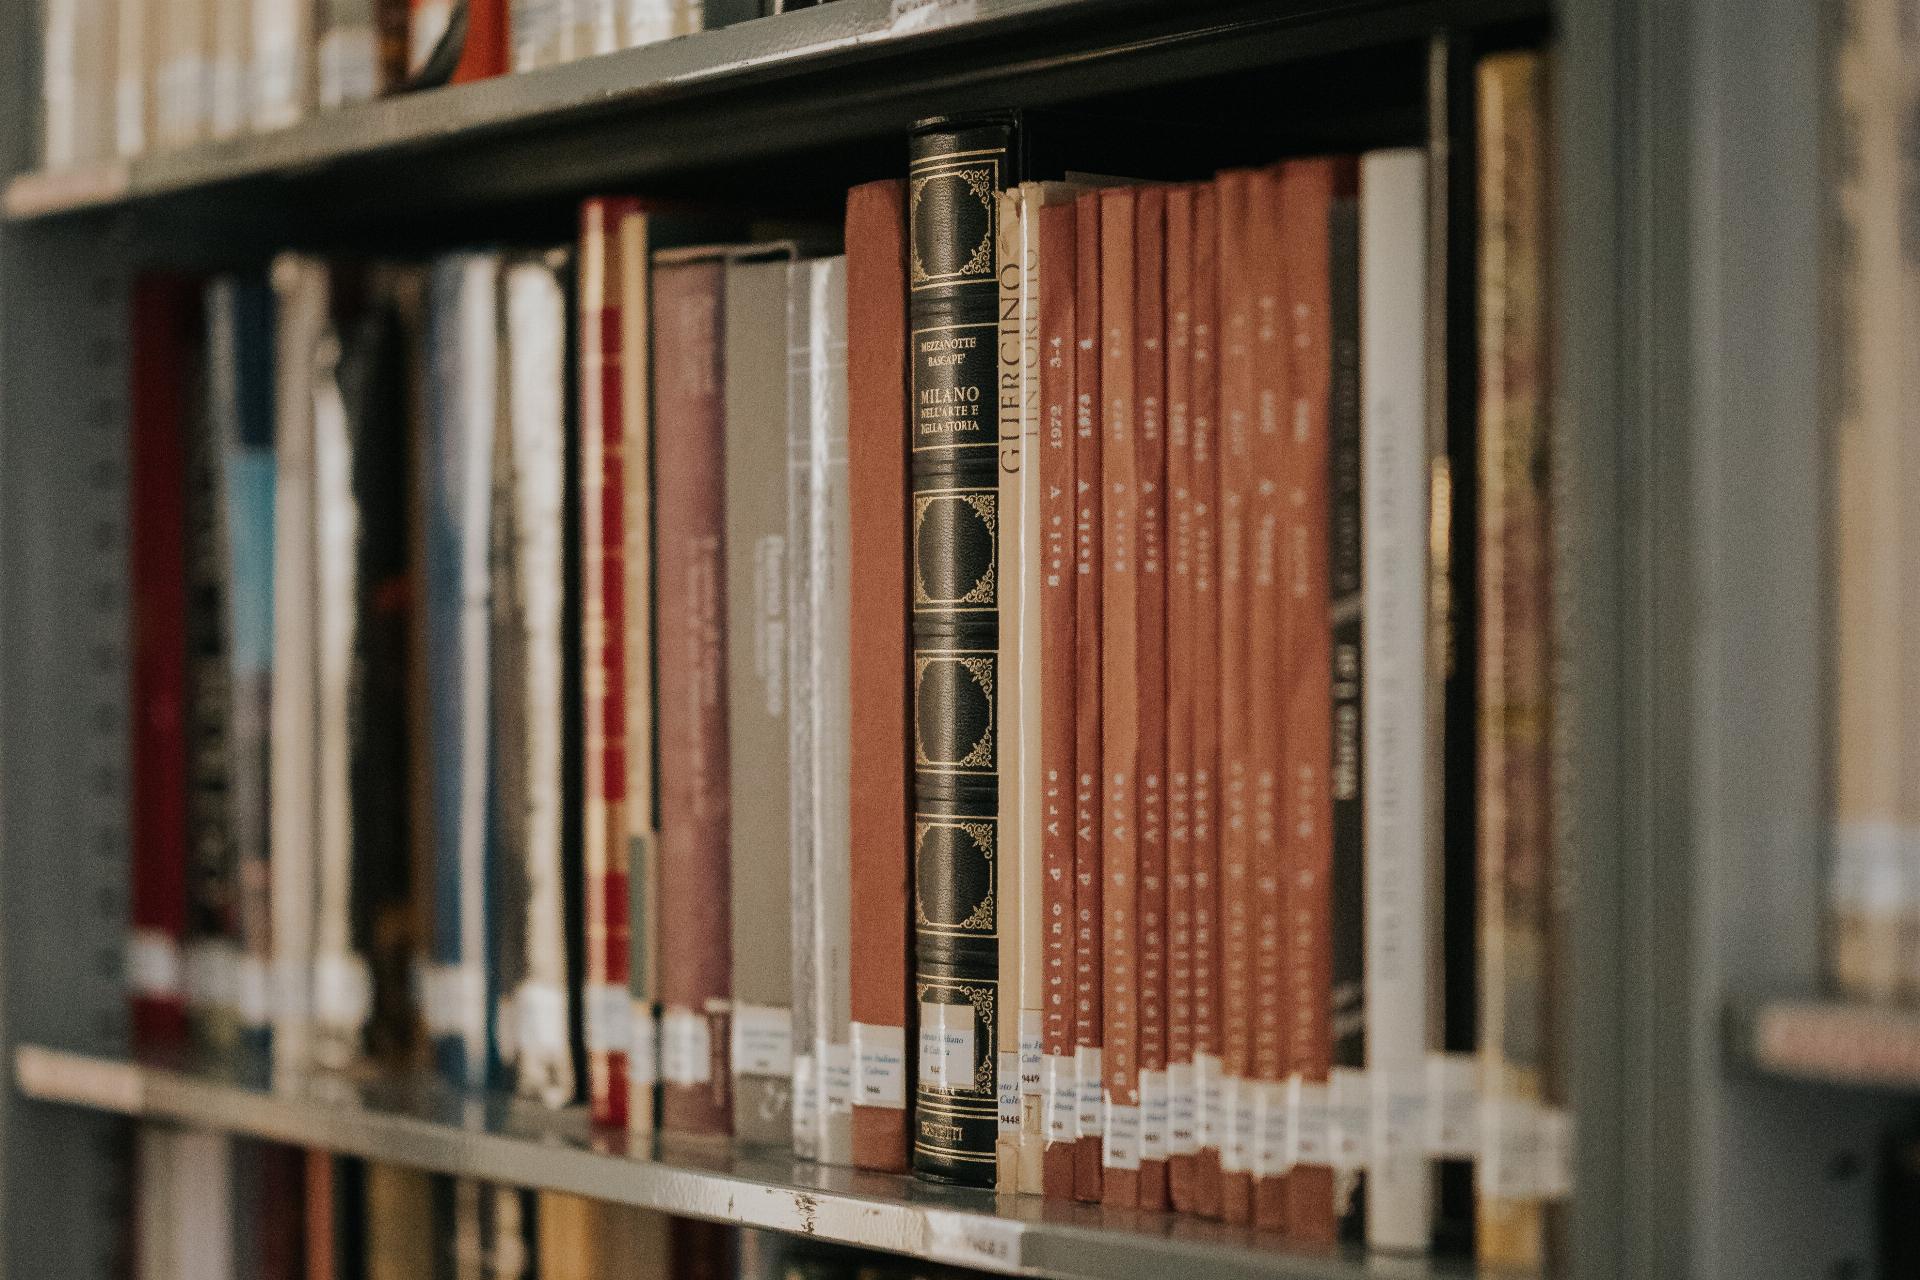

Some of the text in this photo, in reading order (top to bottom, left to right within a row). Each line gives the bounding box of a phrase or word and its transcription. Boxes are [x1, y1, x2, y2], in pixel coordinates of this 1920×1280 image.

[921, 337, 977, 353] MEZZANOTTE
[1000, 262, 1020, 474] GUERCINO
[921, 386, 980, 404] MILANO
[921, 420, 980, 435] NELLA STORIA
[1049, 902, 1062, 1056] ollettino
[1000, 1114, 1020, 1125] 9448
